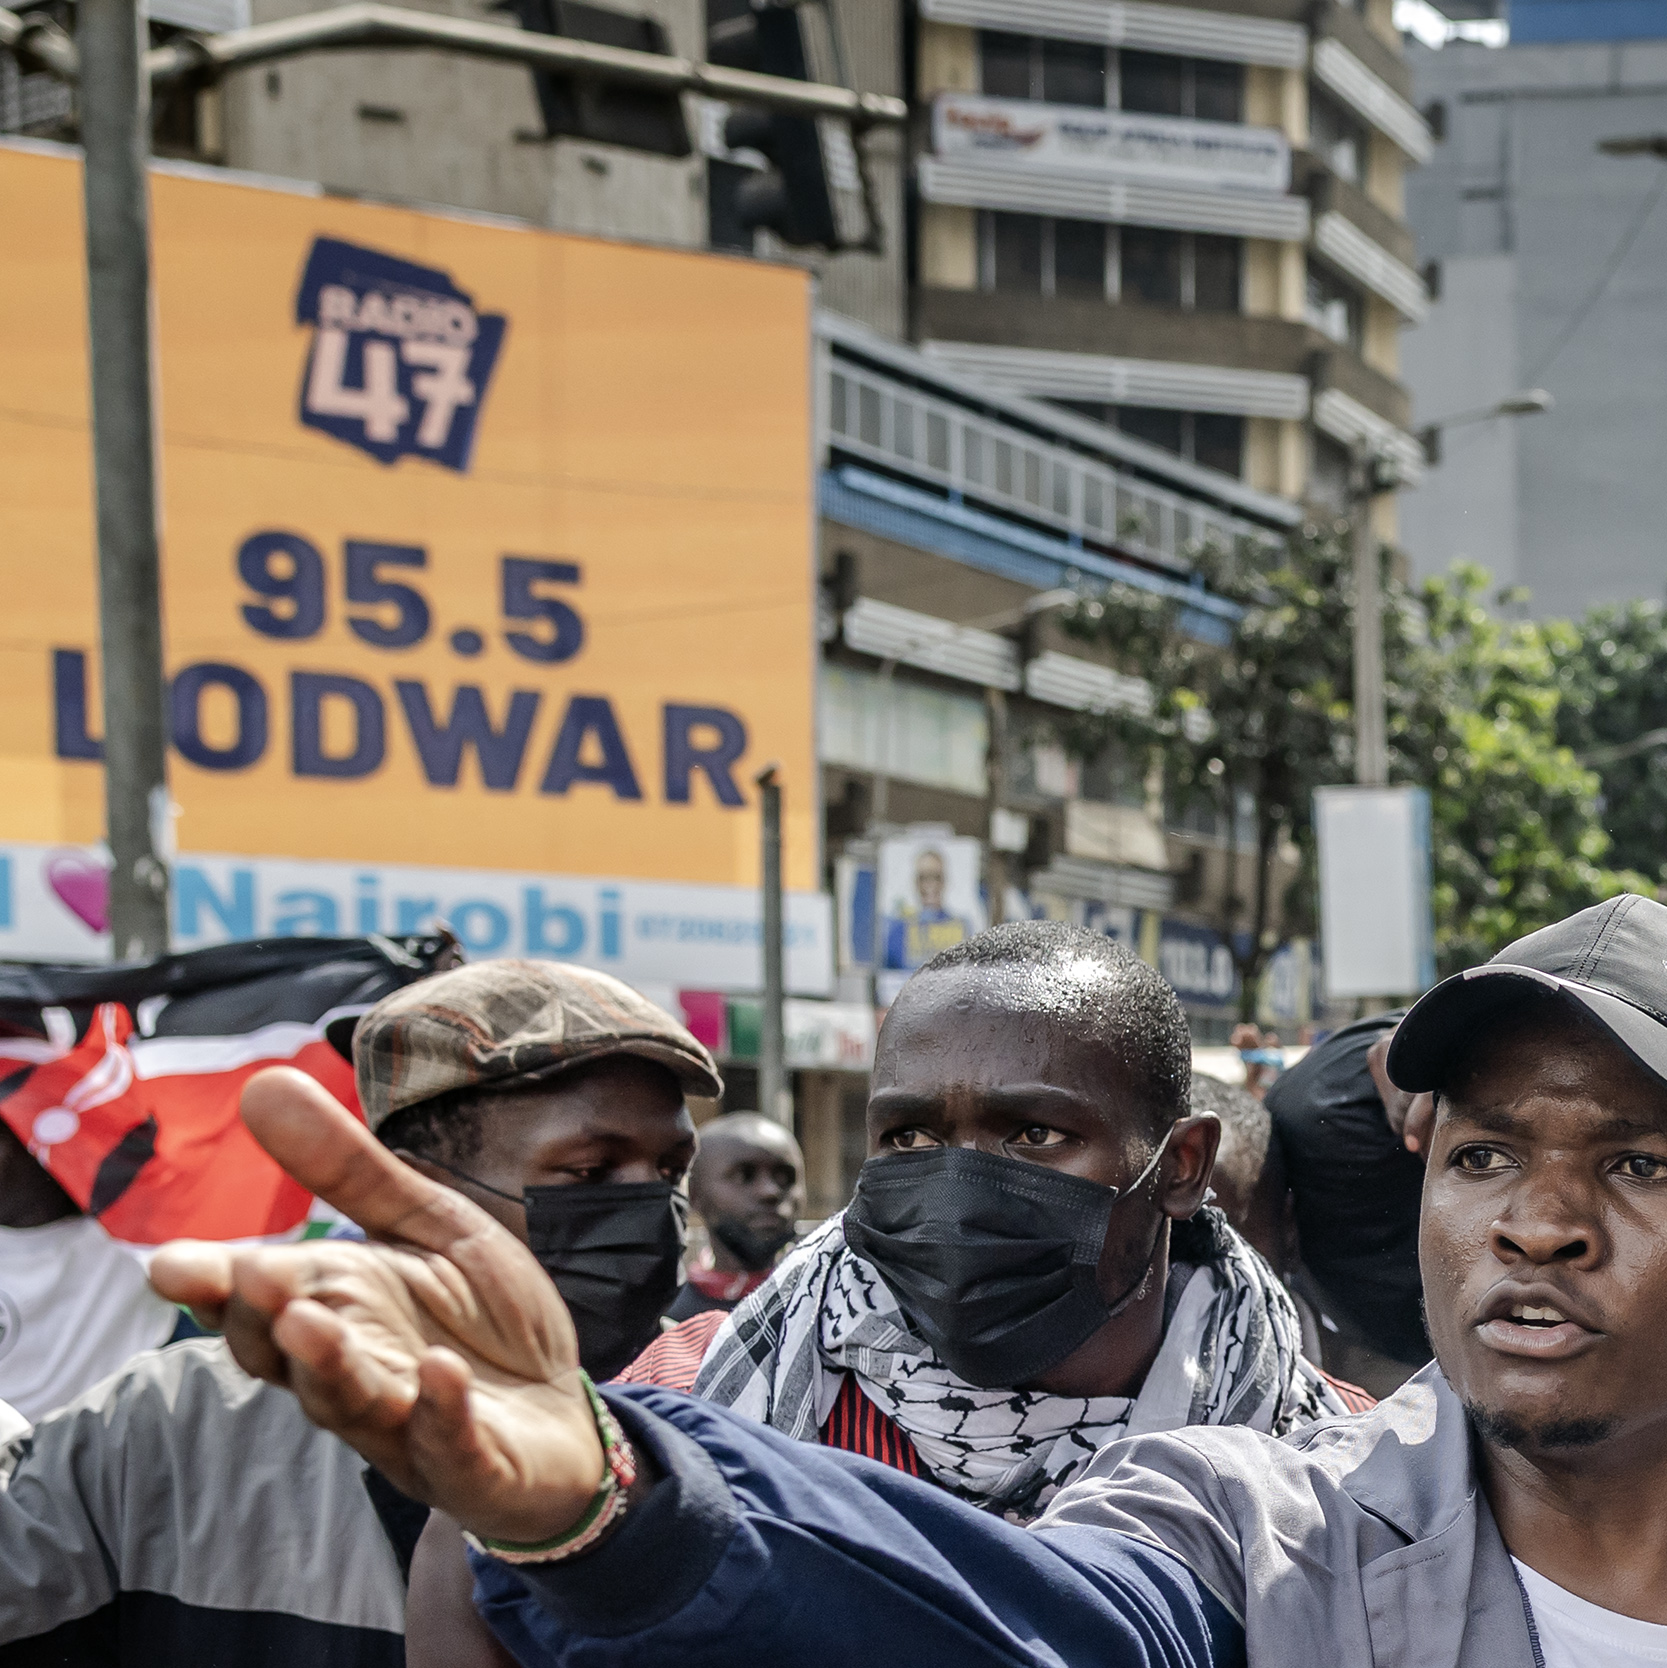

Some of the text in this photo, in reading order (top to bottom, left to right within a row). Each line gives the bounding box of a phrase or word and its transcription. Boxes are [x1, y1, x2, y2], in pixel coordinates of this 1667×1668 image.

[318, 283, 478, 348] RADIO
[307, 328, 476, 450] 47
[235, 529, 587, 666] 95.5
[50, 648, 750, 809] LODWAR
[176, 866, 623, 960] Nairobi
